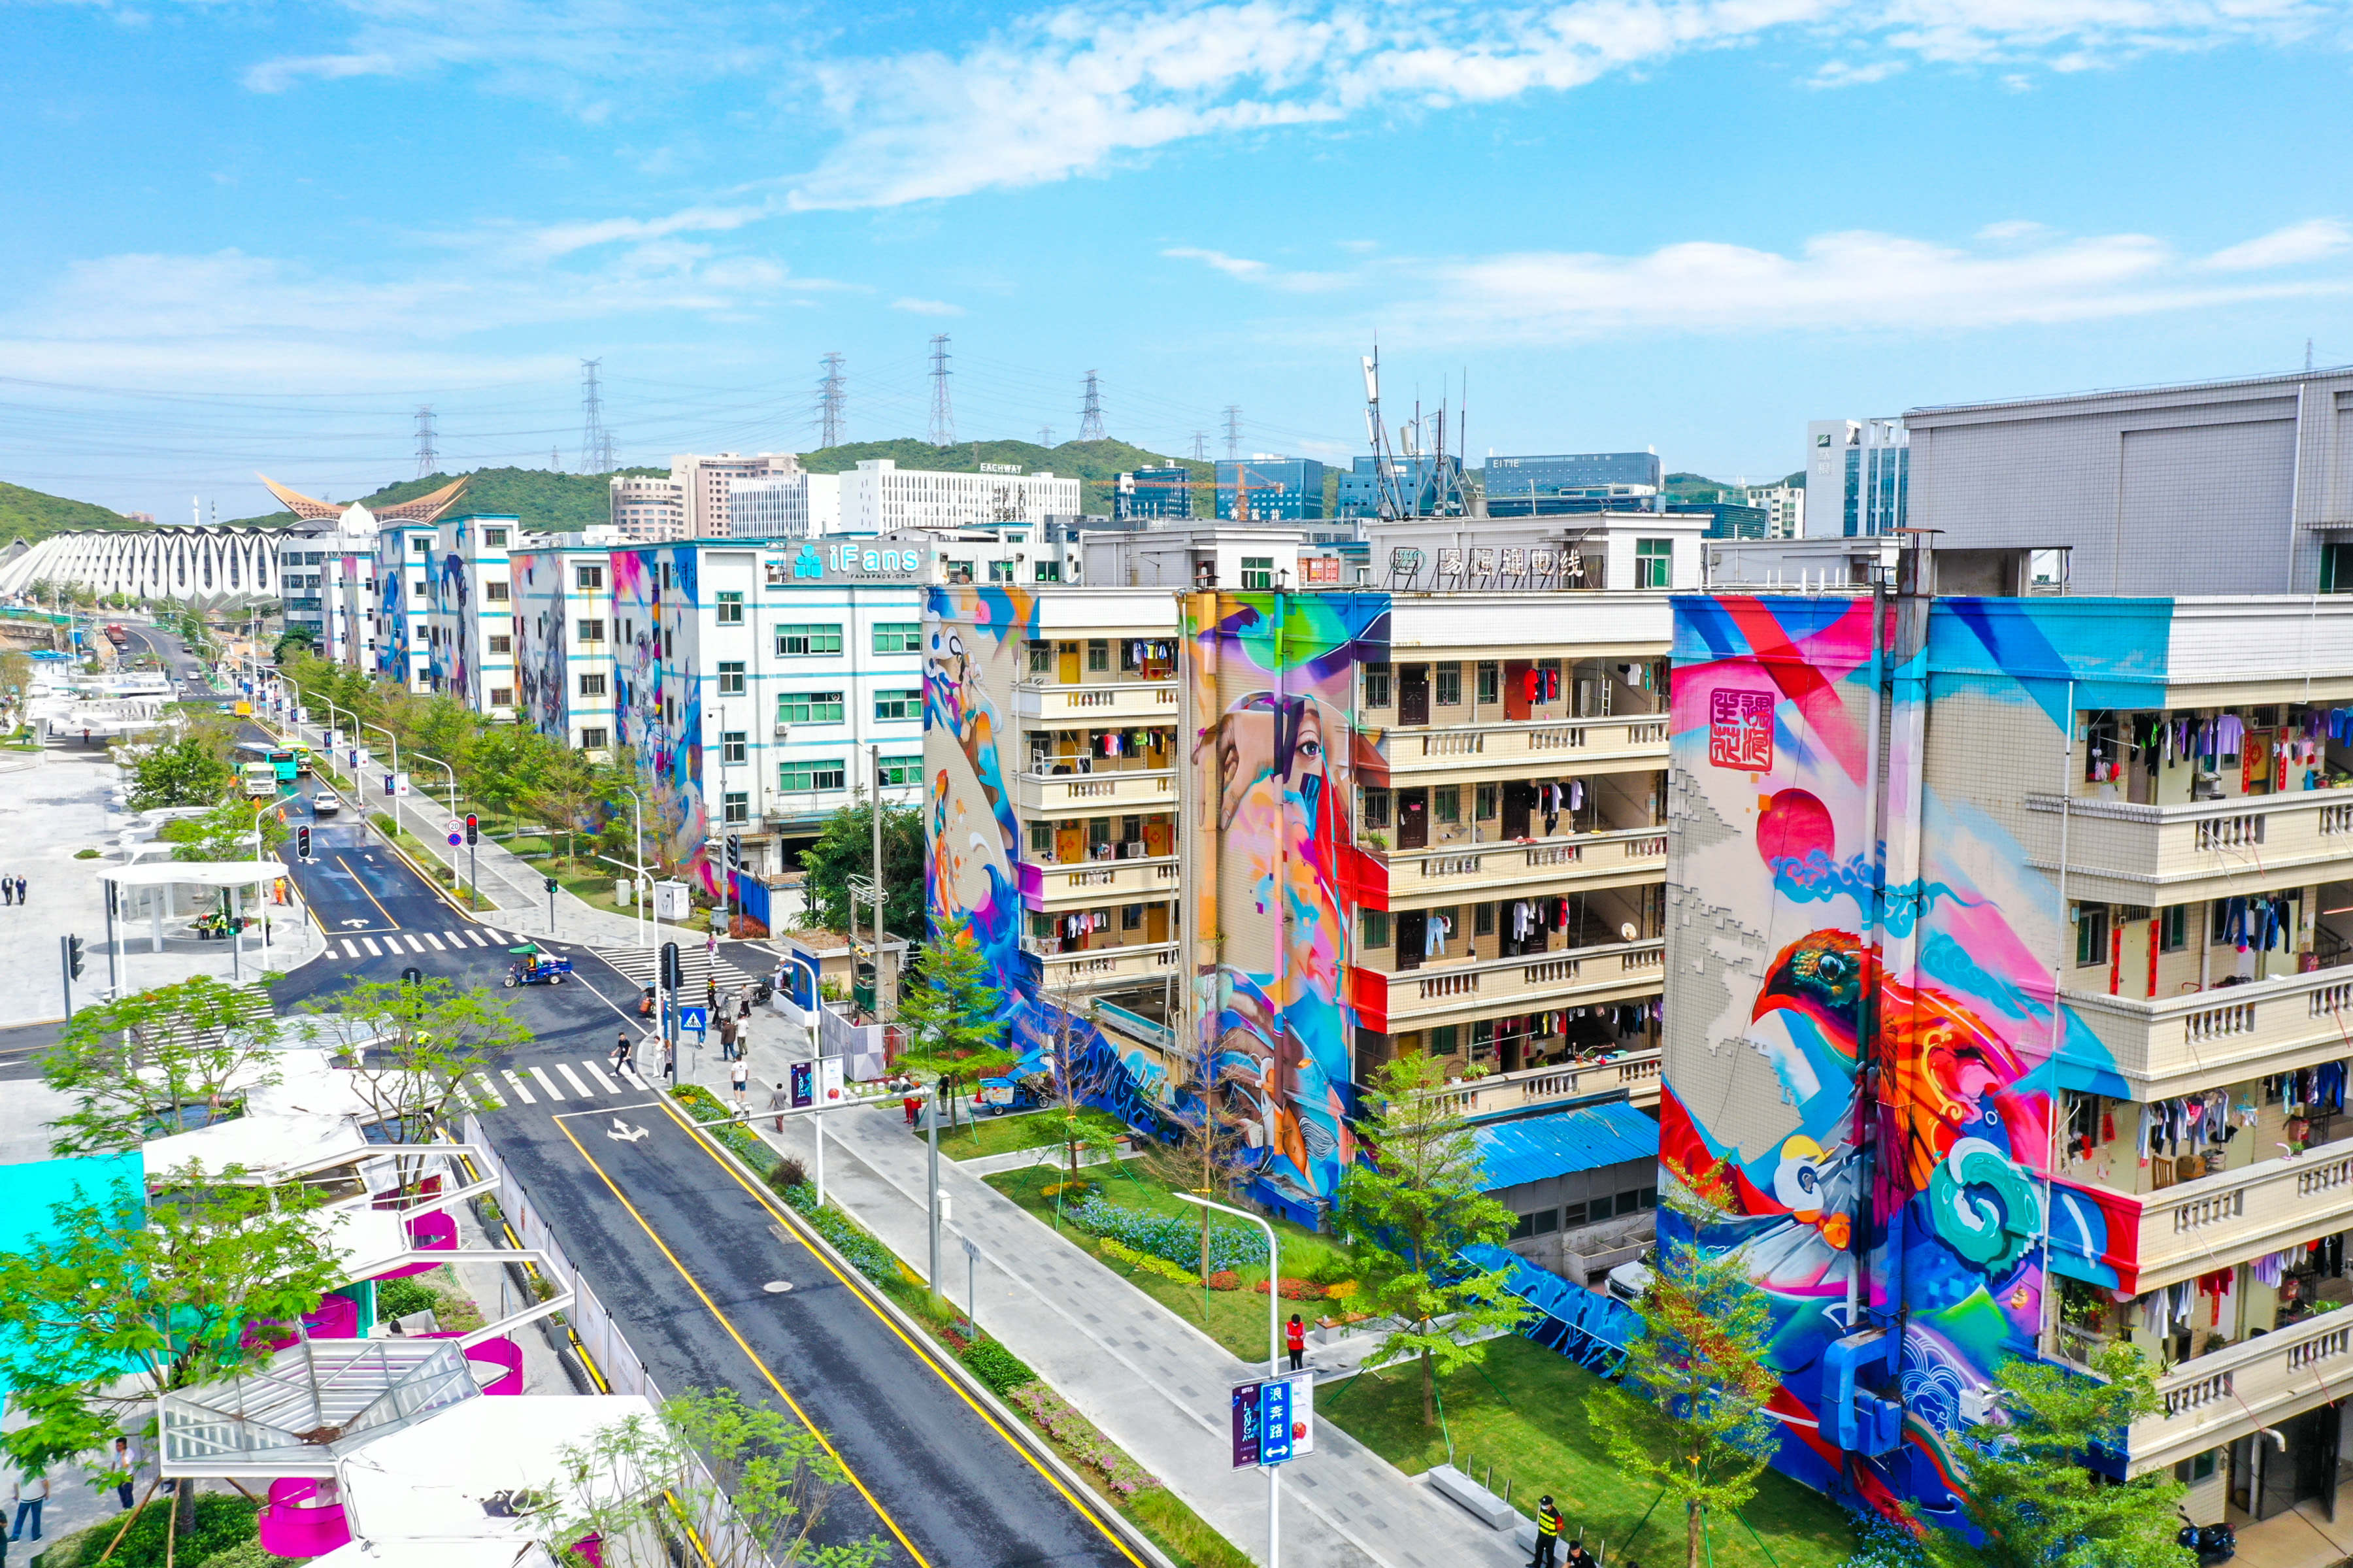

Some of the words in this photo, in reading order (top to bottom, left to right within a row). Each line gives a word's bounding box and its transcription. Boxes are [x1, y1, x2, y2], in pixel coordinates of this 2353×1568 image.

[980, 463, 1022, 473] EACHWAY
[1493, 459, 1520, 468] EITIE
[829, 543, 919, 571] iFans
[1269, 1386, 1283, 1440] 浪奔路
